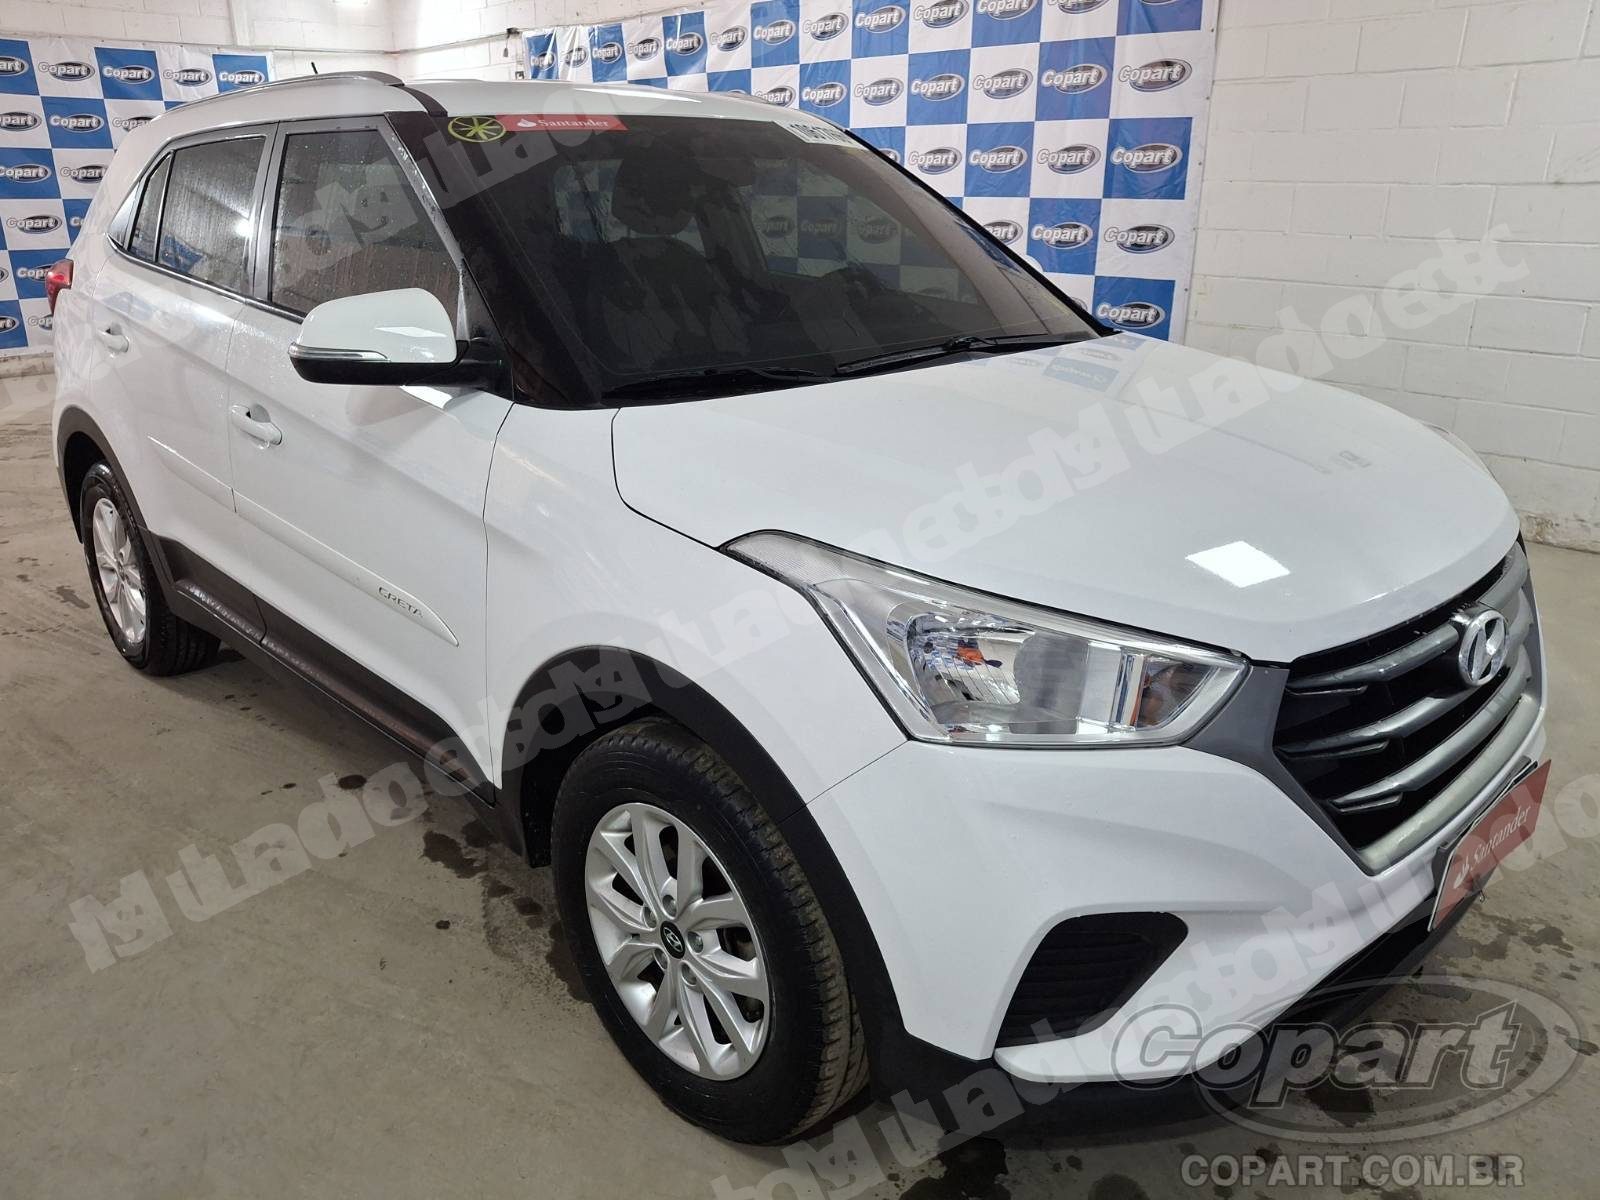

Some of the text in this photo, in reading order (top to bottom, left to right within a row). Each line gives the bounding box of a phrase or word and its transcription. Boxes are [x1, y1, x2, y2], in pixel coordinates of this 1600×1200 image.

[855, 10, 899, 29] Copart
[913, 3, 961, 23] Copart
[753, 23, 791, 41] Copart
[803, 17, 842, 34] Copart
[666, 36, 699, 52] Copart
[39, 61, 88, 77] Copart
[103, 65, 149, 80] Copart
[163, 69, 205, 82] Copart
[219, 71, 259, 83] Copart
[1041, 67, 1099, 87] Copart
[1119, 62, 1184, 86] Copart
[854, 82, 898, 99] Copart
[911, 79, 958, 97] Copart
[973, 74, 1026, 93] Copart
[802, 85, 841, 102] Copart
[0, 114, 34, 128] part
[50, 114, 99, 129] Copart
[538, 117, 609, 128] Santander
[909, 150, 956, 168] Copart
[969, 148, 1020, 168] Copart
[1037, 148, 1092, 168] Copart
[1110, 146, 1173, 168] Copart
[7, 217, 55, 230] Copart
[1031, 223, 1085, 243] Copart
[1105, 226, 1166, 247] Copart
[1097, 303, 1157, 323] Copart
[379, 586, 424, 619] CRETA
